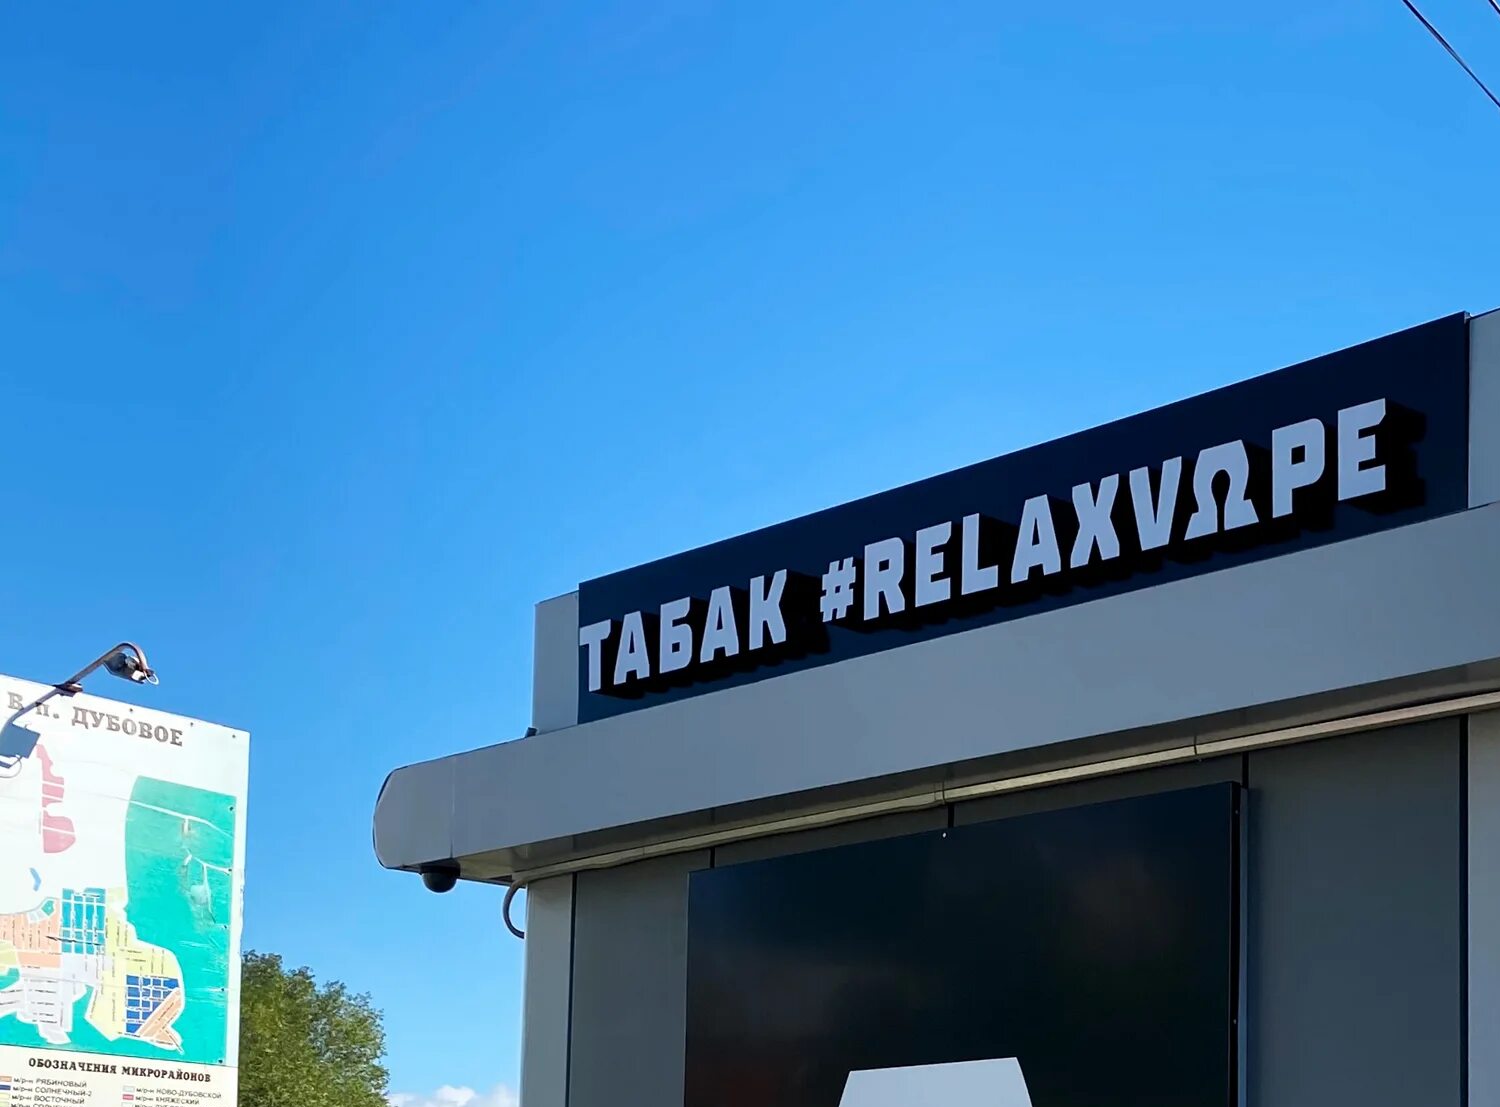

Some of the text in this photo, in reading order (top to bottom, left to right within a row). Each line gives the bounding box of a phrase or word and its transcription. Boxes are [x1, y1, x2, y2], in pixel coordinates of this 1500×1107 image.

[579, 568, 788, 693] ТАБАК
[72, 706, 183, 747] ДУБОВОЕ
[29, 1058, 211, 1082] ОБОЗНАЧЕНИЯ МИКРОРАЙОНОВ
